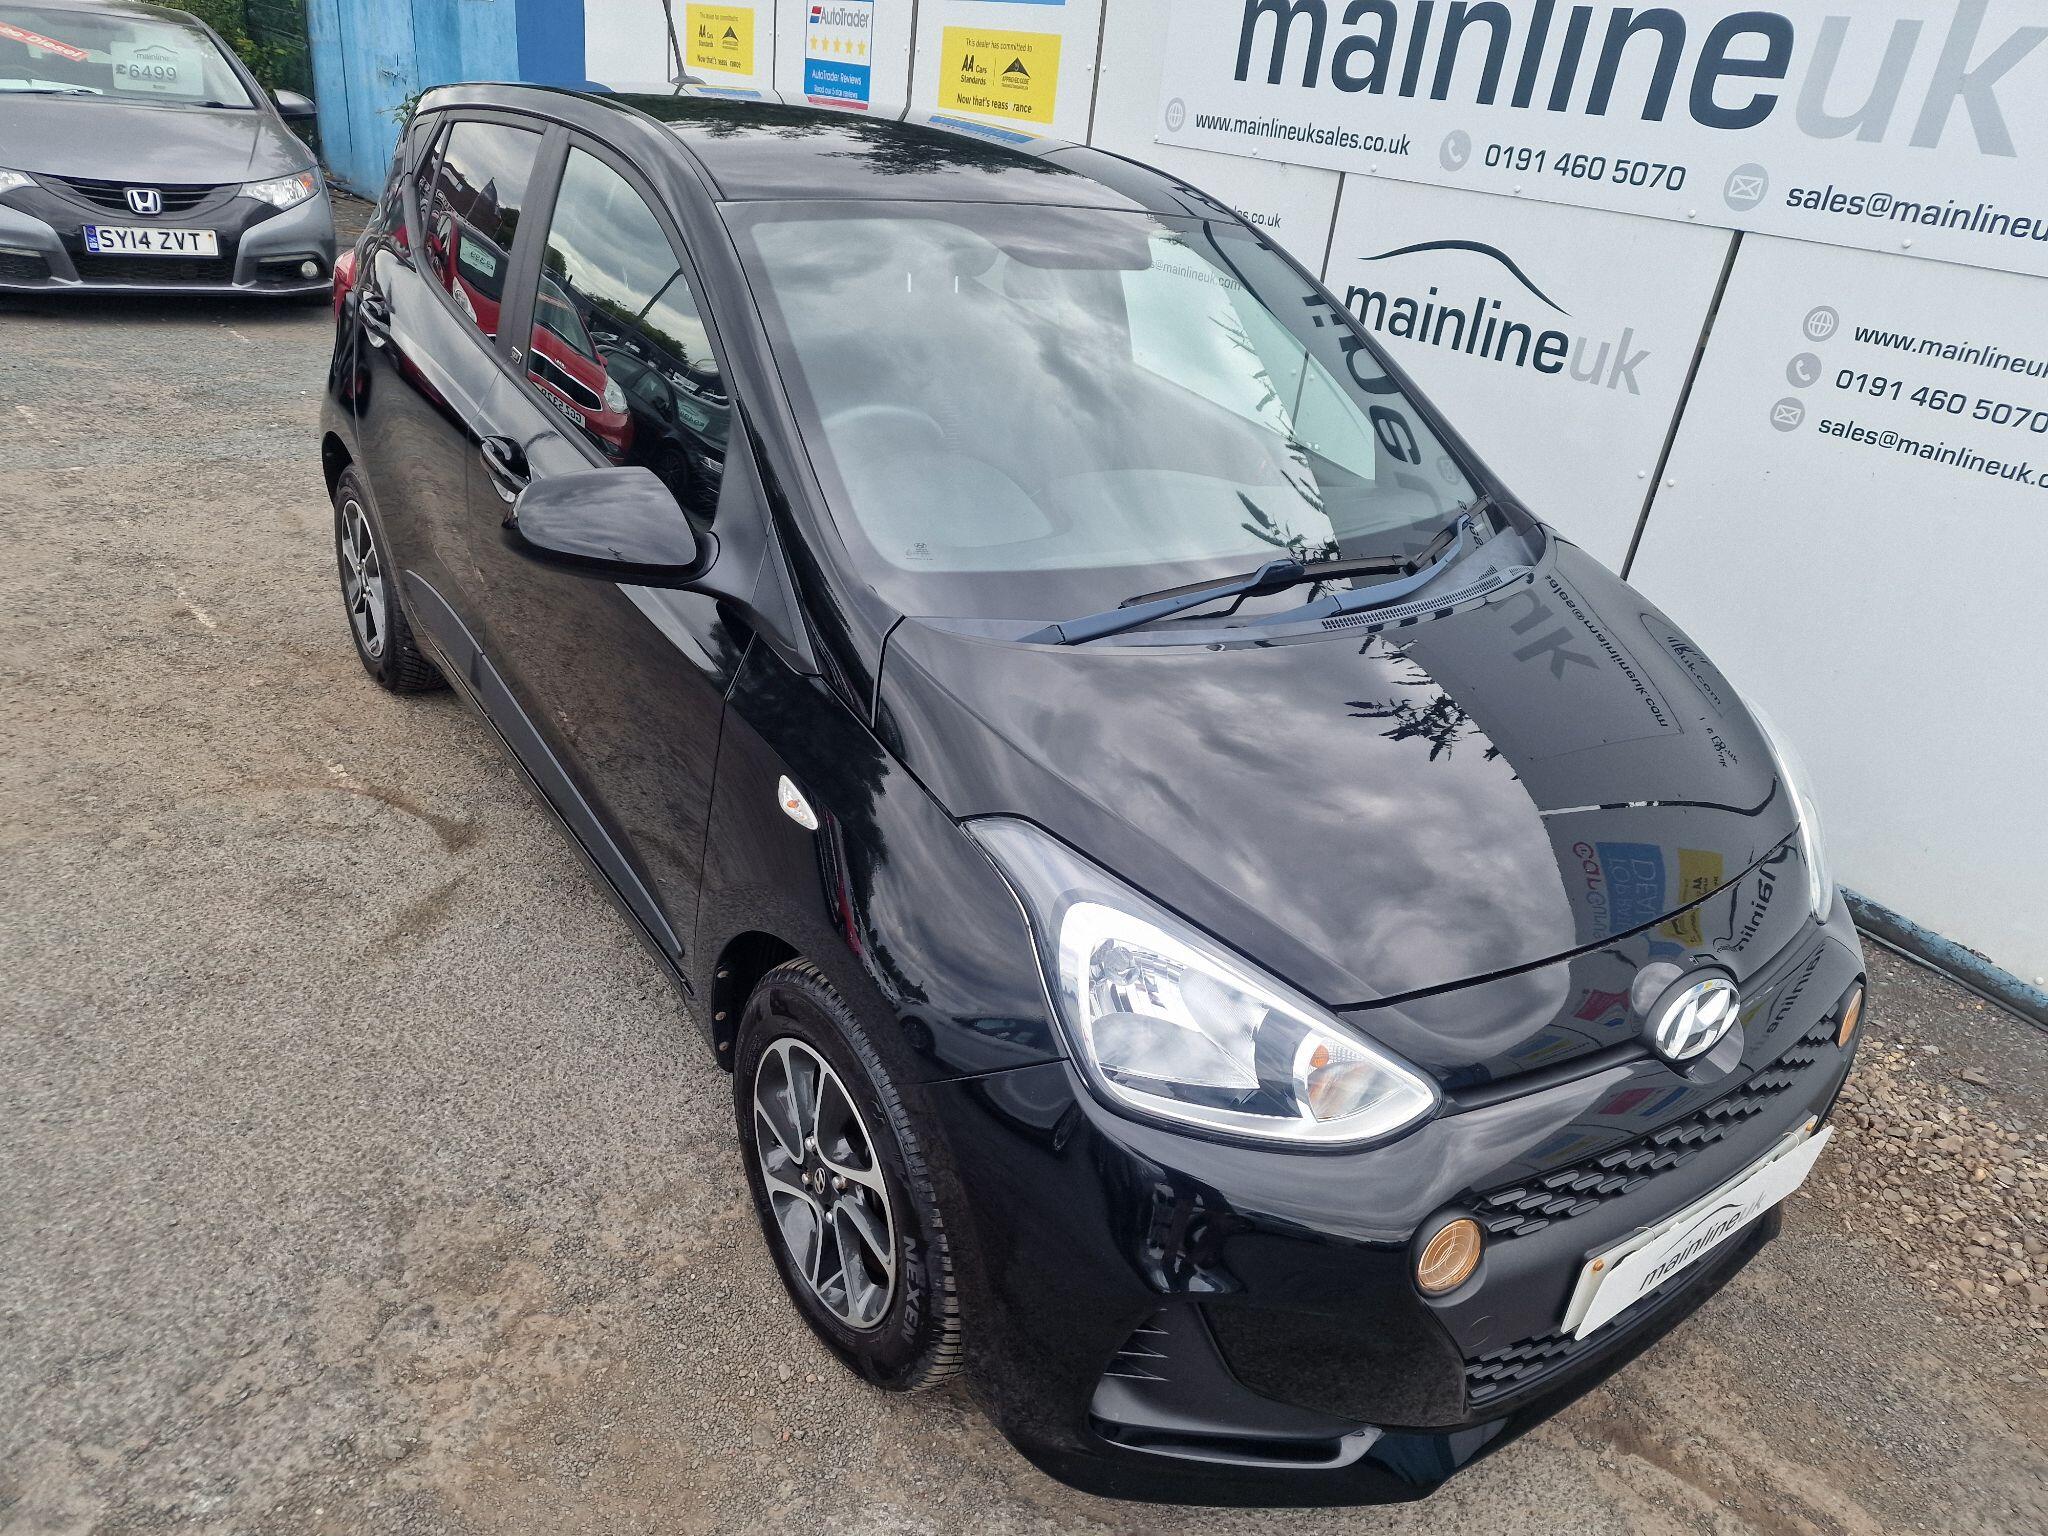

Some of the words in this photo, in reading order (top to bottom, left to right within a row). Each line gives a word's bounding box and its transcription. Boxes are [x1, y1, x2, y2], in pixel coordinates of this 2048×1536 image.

[820, 7, 869, 28] AutoTrader
[960, 74, 987, 86] Standards
[961, 54, 975, 72] AA
[976, 65, 988, 74] Cars
[957, 93, 972, 105] Now
[972, 95, 990, 107] that's
[1195, 113, 1411, 156] www.mainlineuksales.co.uk
[1485, 143, 1547, 173] 0191
[1554, 152, 1607, 181] 460
[1612, 159, 1687, 191] 5070
[100, 229, 151, 250] SY14
[158, 231, 200, 251] ZVT
[1344, 285, 1652, 396] mainlineuk
[1835, 369, 1903, 401] 0191
[1910, 386, 1967, 415] 460
[1972, 398, 2048, 434] 5070
[901, 1236, 920, 1344] NEXEN
